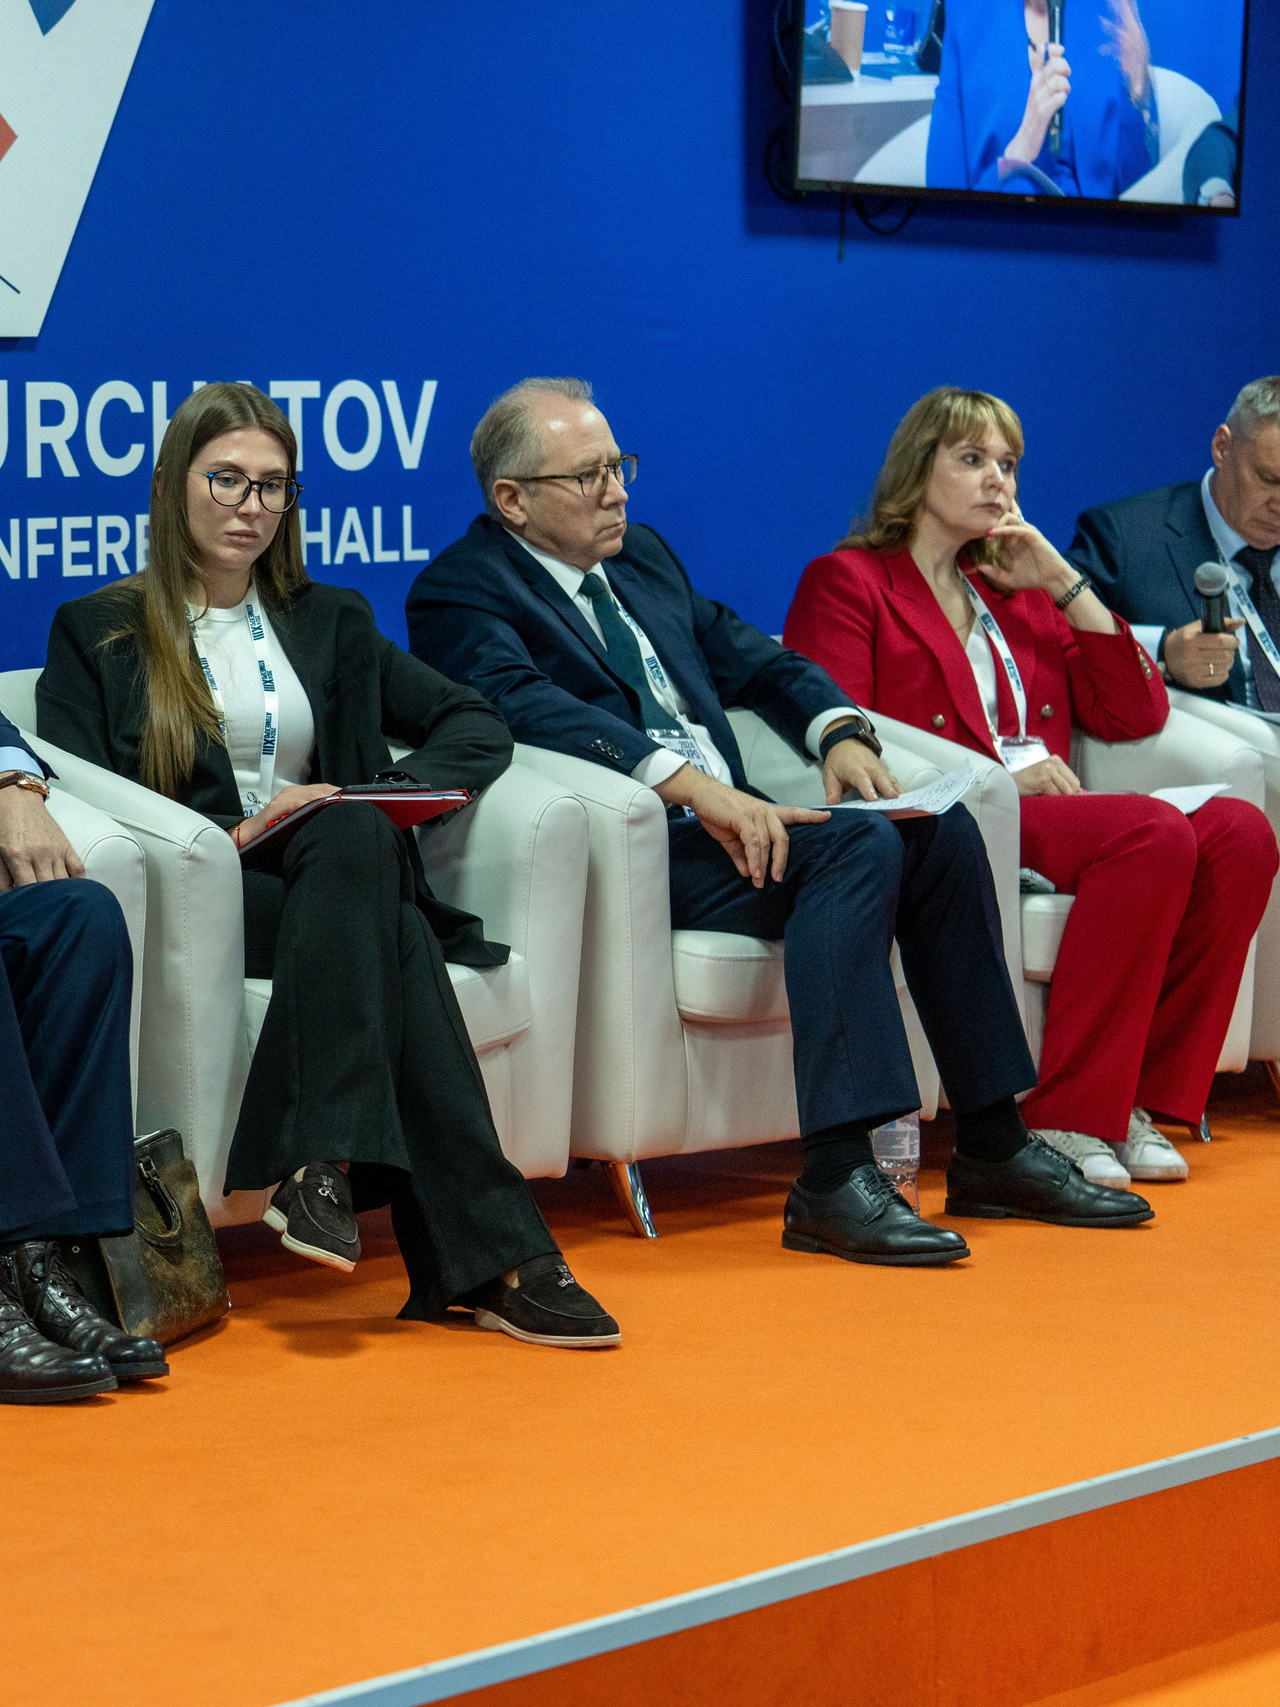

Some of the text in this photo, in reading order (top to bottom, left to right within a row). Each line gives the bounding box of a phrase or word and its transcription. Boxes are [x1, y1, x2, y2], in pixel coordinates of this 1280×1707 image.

[298, 504, 430, 567] HALL
[250, 624, 265, 641] XIII
[261, 679, 276, 692] XIII
[261, 711, 276, 756] ATOMEXPO XIII
